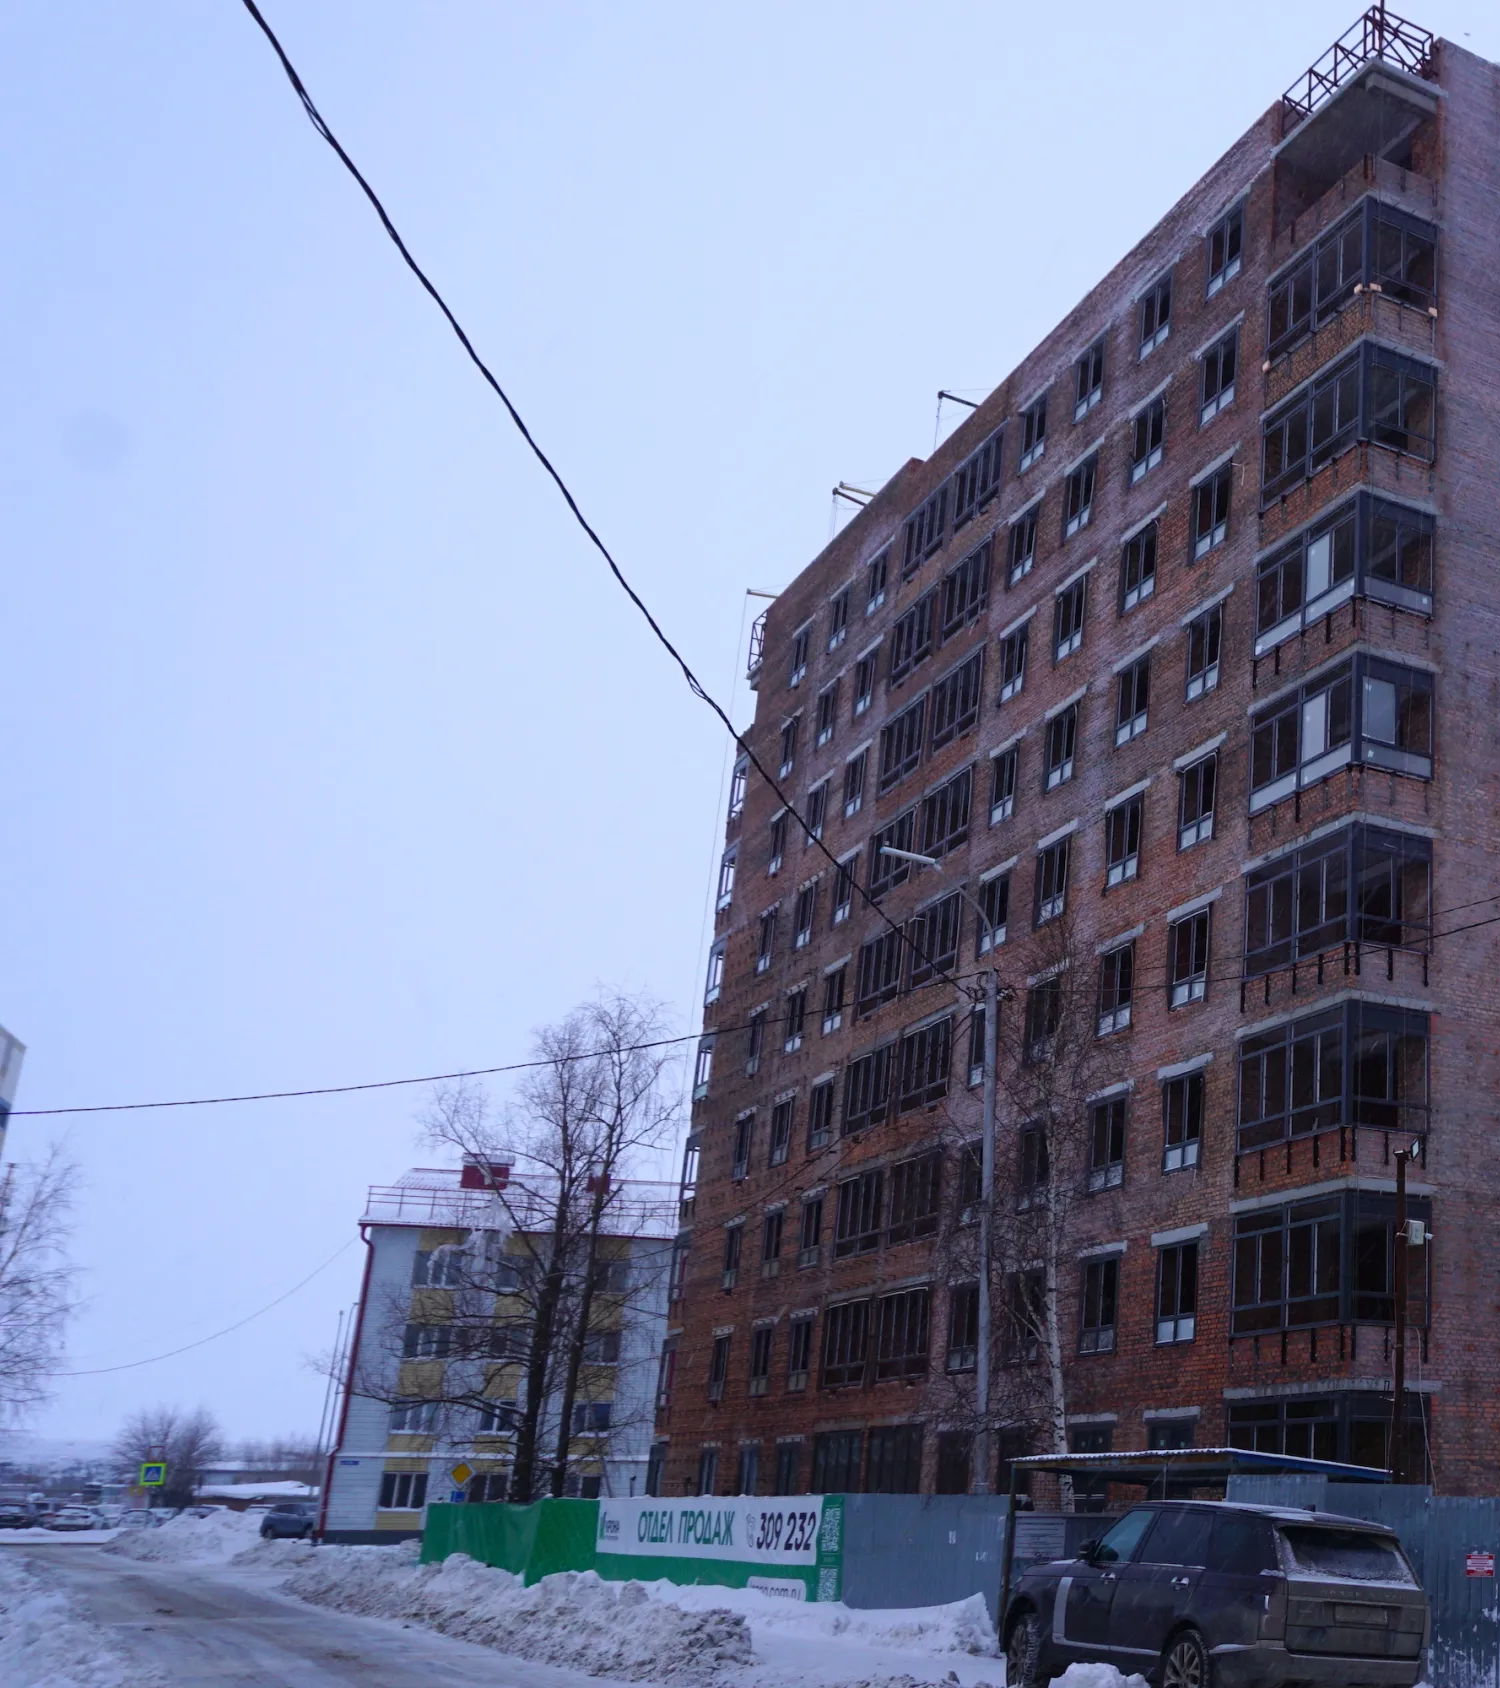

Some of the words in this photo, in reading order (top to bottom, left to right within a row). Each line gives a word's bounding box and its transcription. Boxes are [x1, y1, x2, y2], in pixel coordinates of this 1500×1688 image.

[638, 1511, 673, 1543] ОТДЕЛ
[677, 1510, 736, 1546] ПРОДАЖ
[757, 1511, 783, 1551] 309
[784, 1511, 817, 1551] 232
